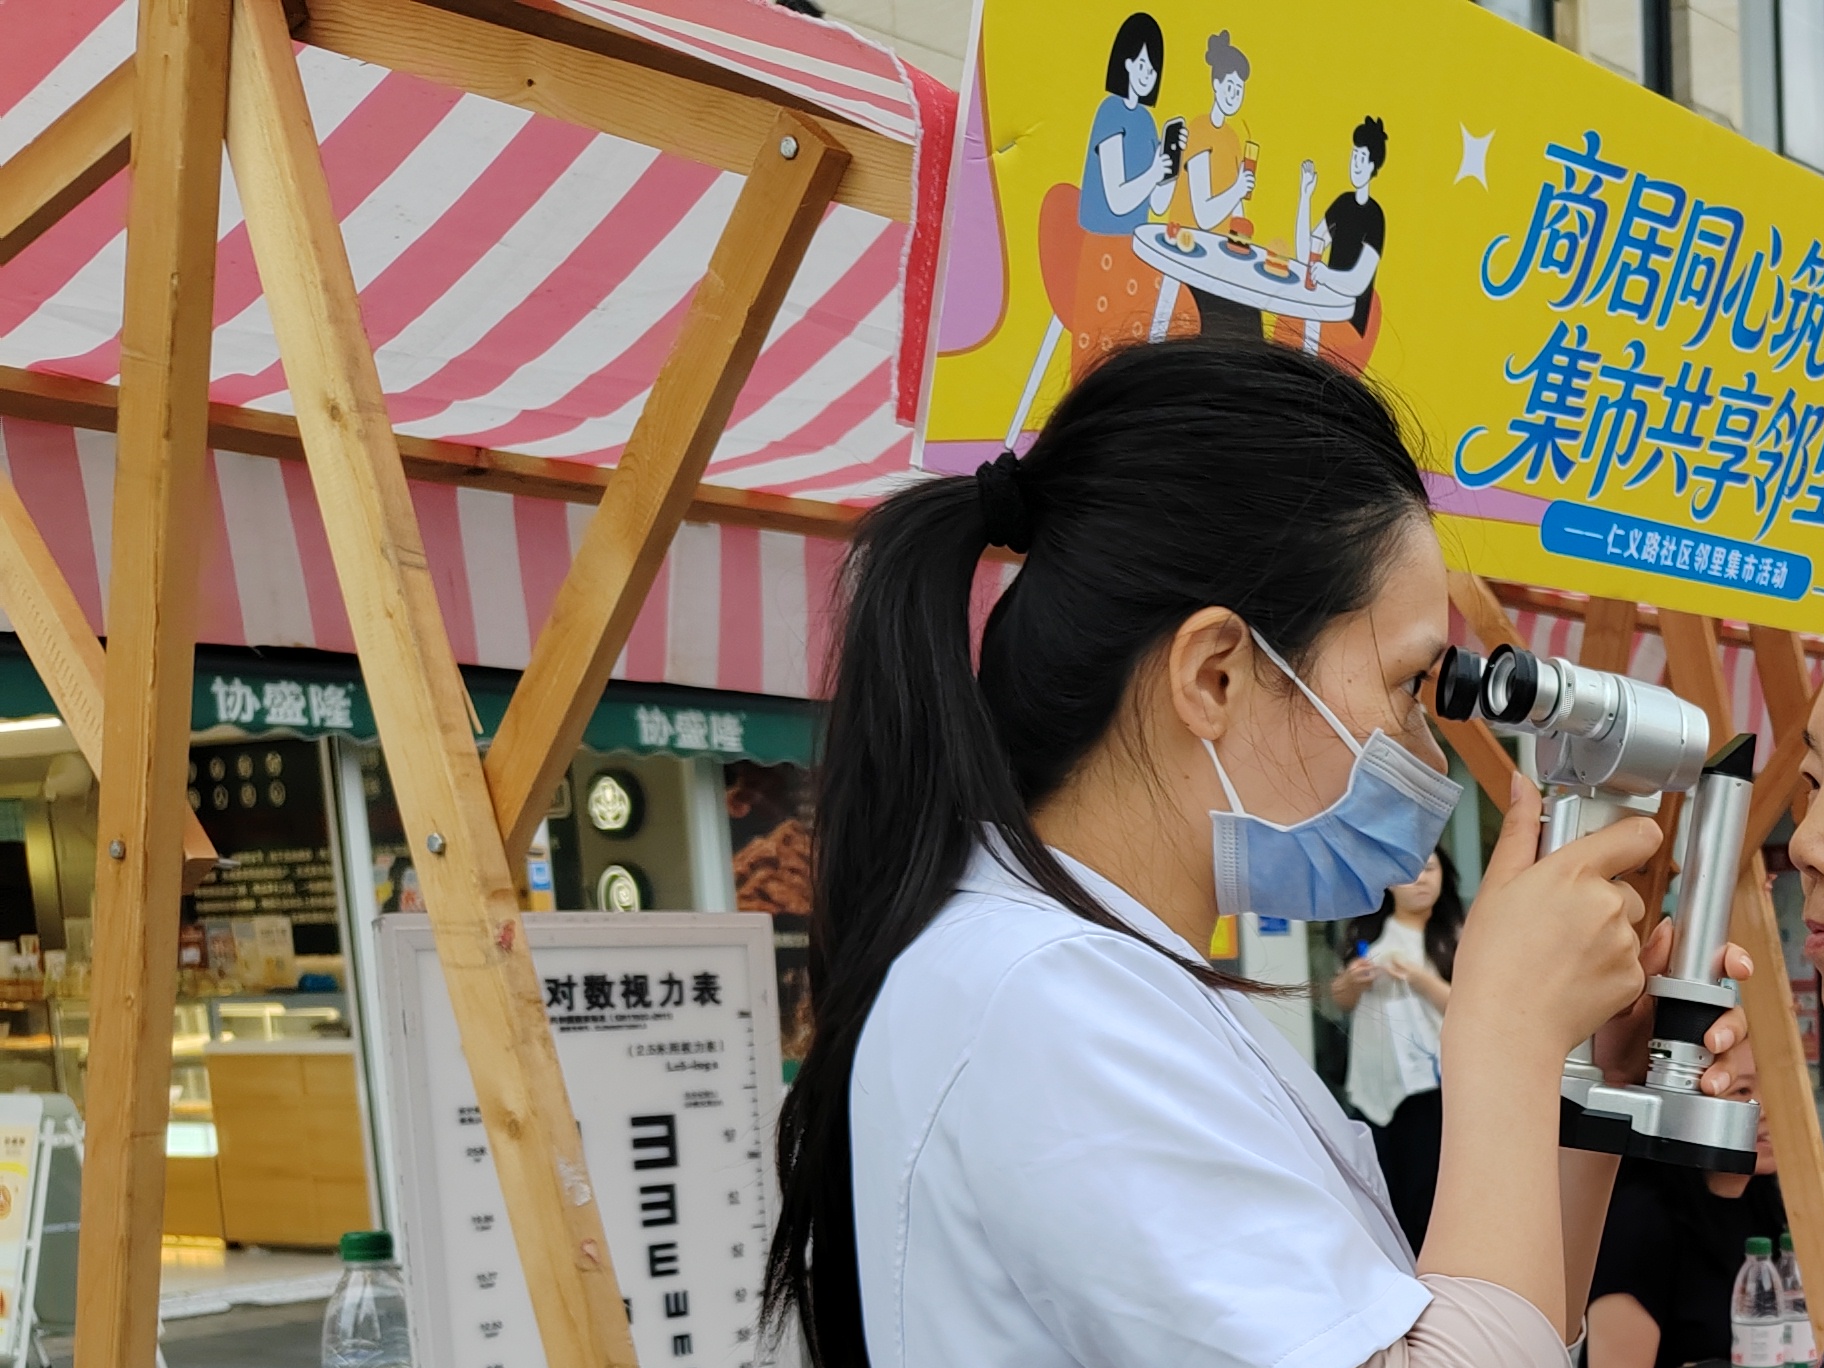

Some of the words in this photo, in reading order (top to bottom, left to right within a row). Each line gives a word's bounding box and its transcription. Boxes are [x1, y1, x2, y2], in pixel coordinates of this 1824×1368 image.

[211, 676, 354, 729] 协盛隆
[636, 705, 745, 753] 协盛隆
